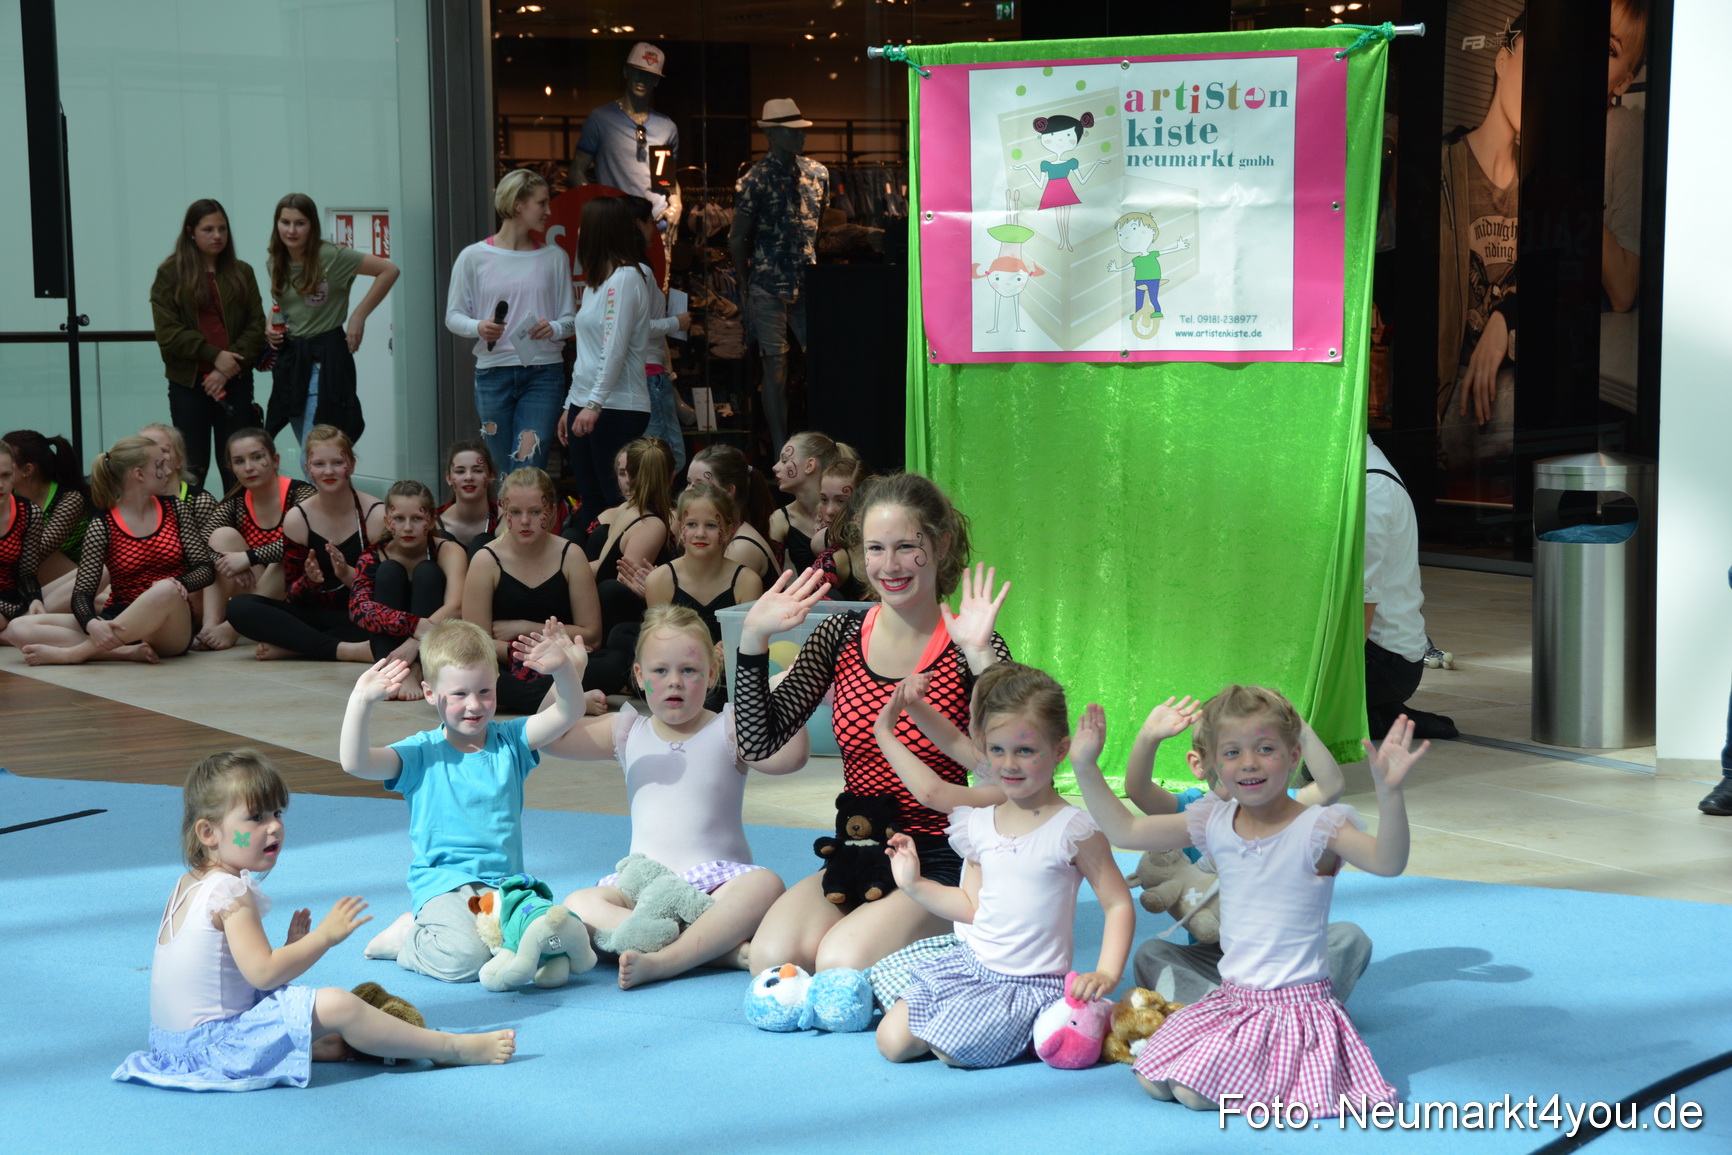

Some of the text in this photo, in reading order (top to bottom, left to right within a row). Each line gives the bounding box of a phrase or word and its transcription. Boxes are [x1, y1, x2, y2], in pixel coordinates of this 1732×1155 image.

[1126, 116, 1219, 147] kiste
[1126, 149, 1275, 170] neumarkt gmbh
[1179, 314, 1258, 324] Tel. 09181-238977
[1175, 328, 1263, 338] www.artistenkiste.de
